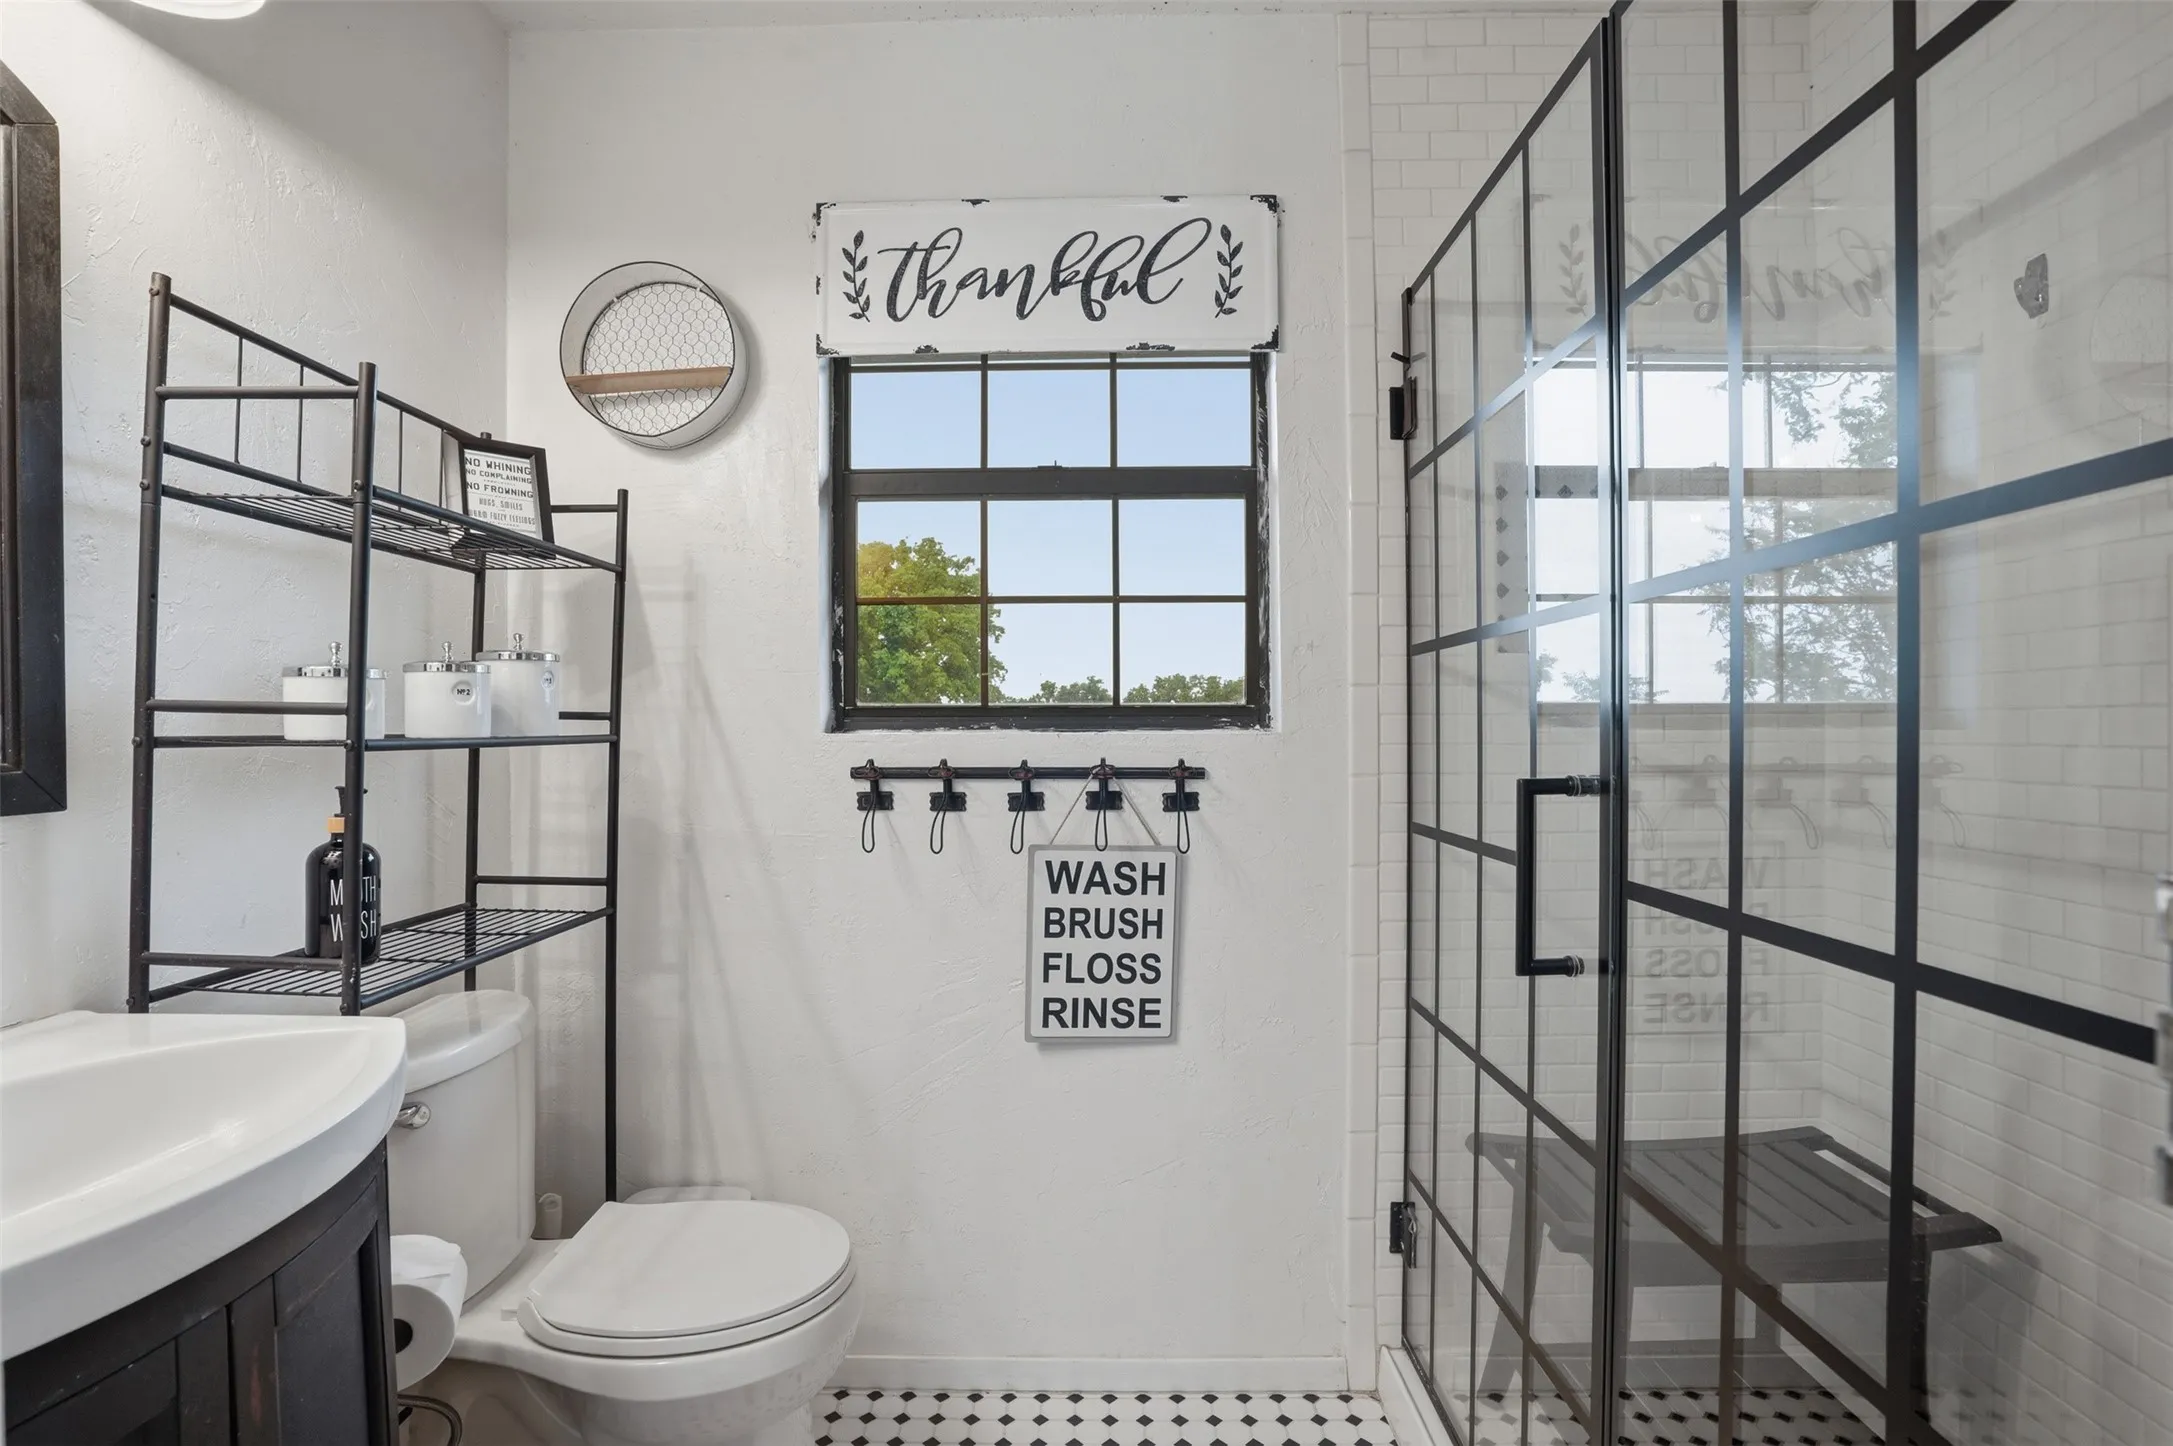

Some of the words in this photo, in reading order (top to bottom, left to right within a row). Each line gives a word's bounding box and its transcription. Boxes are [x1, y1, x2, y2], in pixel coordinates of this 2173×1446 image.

[877, 217, 1212, 322] thankful
[465, 457, 480, 467] NO
[486, 460, 531, 475] WHINING
[480, 470, 532, 484] COMPLAINING
[466, 482, 480, 491] NO
[484, 484, 534, 498] FROWNING
[330, 876, 377, 907] MTH
[1045, 860, 1166, 896] WASH
[330, 910, 377, 943] WSH
[1043, 907, 1164, 940] BRUSH
[1042, 952, 1162, 985] FLOSS
[1041, 997, 1162, 1029] RINSE
